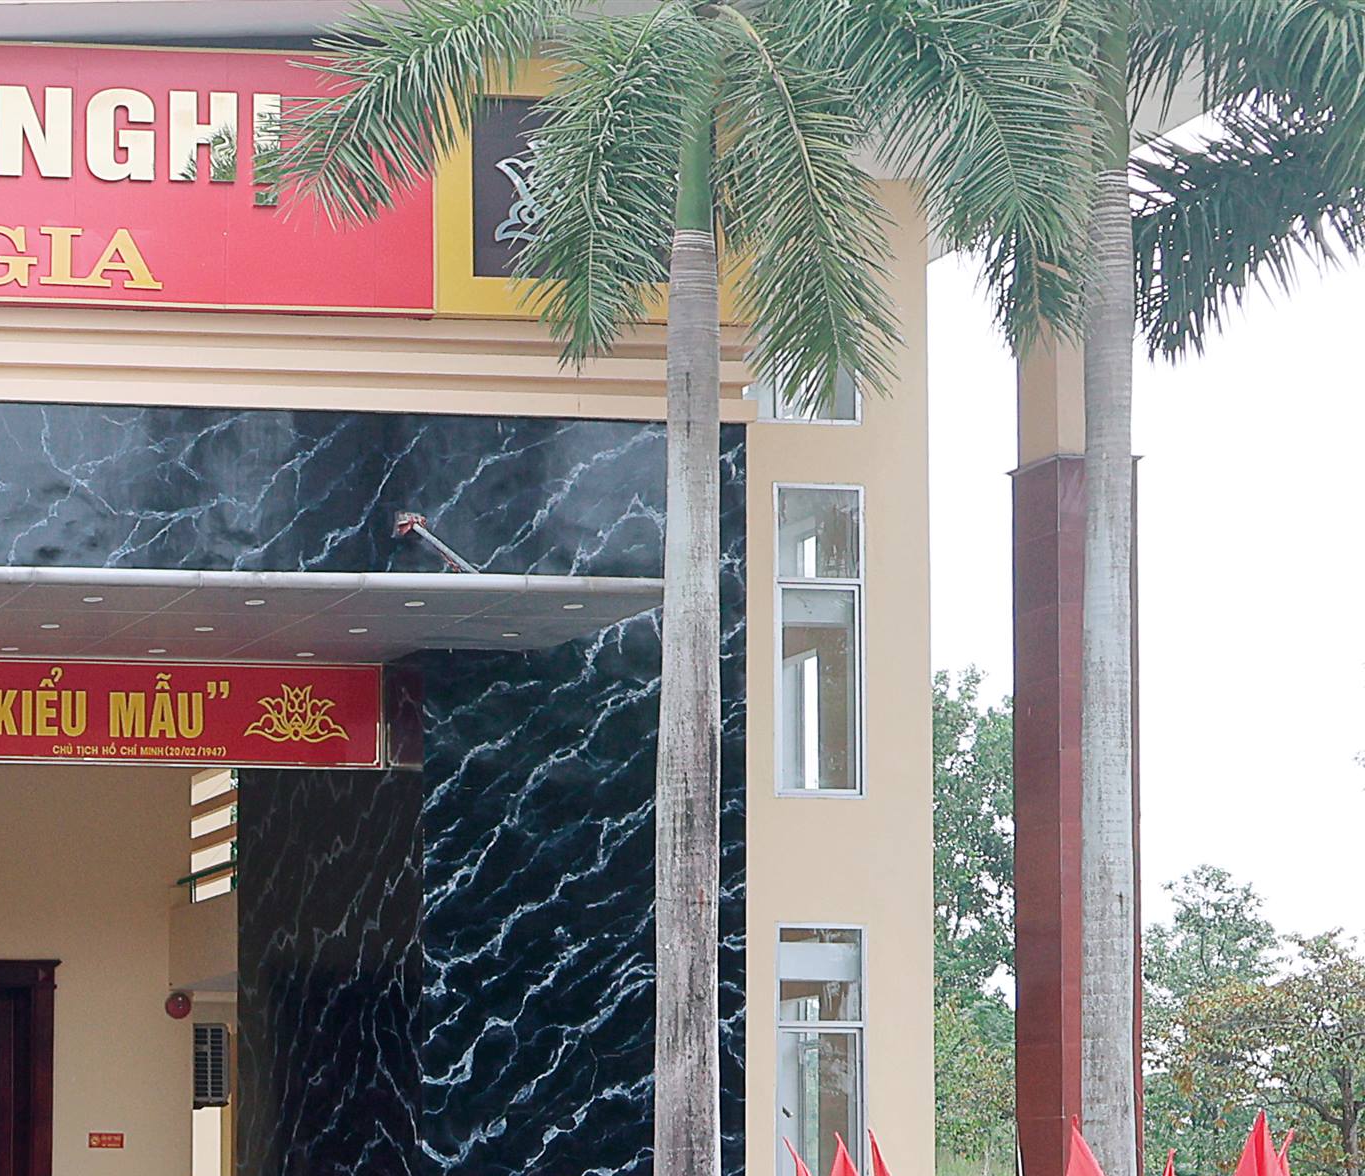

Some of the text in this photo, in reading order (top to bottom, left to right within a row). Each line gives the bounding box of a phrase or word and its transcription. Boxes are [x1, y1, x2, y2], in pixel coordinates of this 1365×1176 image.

[52, 743, 73, 756] CHỦ
[76, 745, 99, 757] TỊCH
[120, 743, 137, 756] CHÍ
